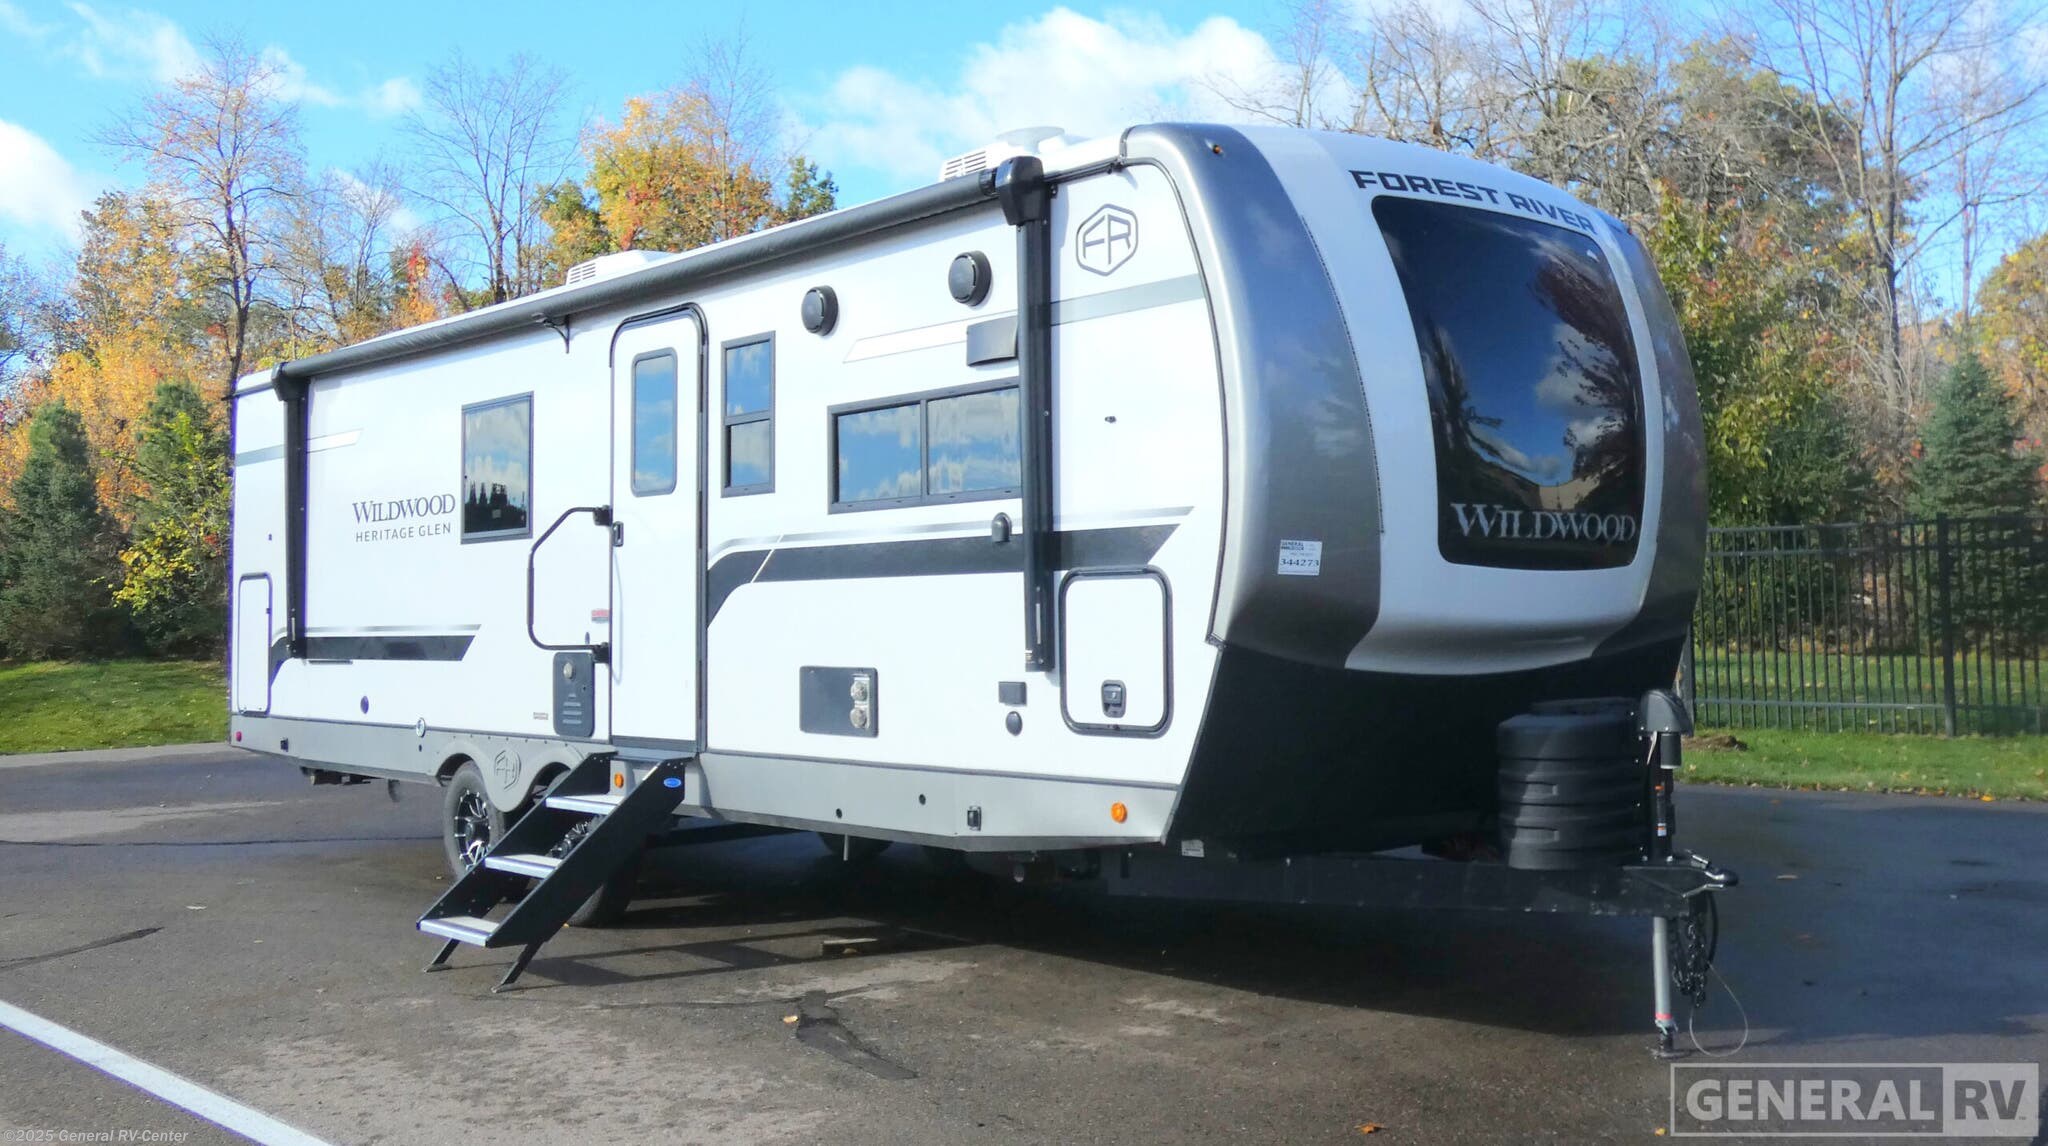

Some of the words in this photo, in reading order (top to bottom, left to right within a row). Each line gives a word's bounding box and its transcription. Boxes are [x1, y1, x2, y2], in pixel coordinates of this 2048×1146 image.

[1349, 169, 1499, 205] FOREST
[1504, 192, 1597, 235] RIVER
[352, 493, 456, 524] WILDWOOD
[1450, 502, 1636, 542] WILDWOOD
[355, 526, 415, 543] HERITAGE
[418, 522, 451, 537] GLEN
